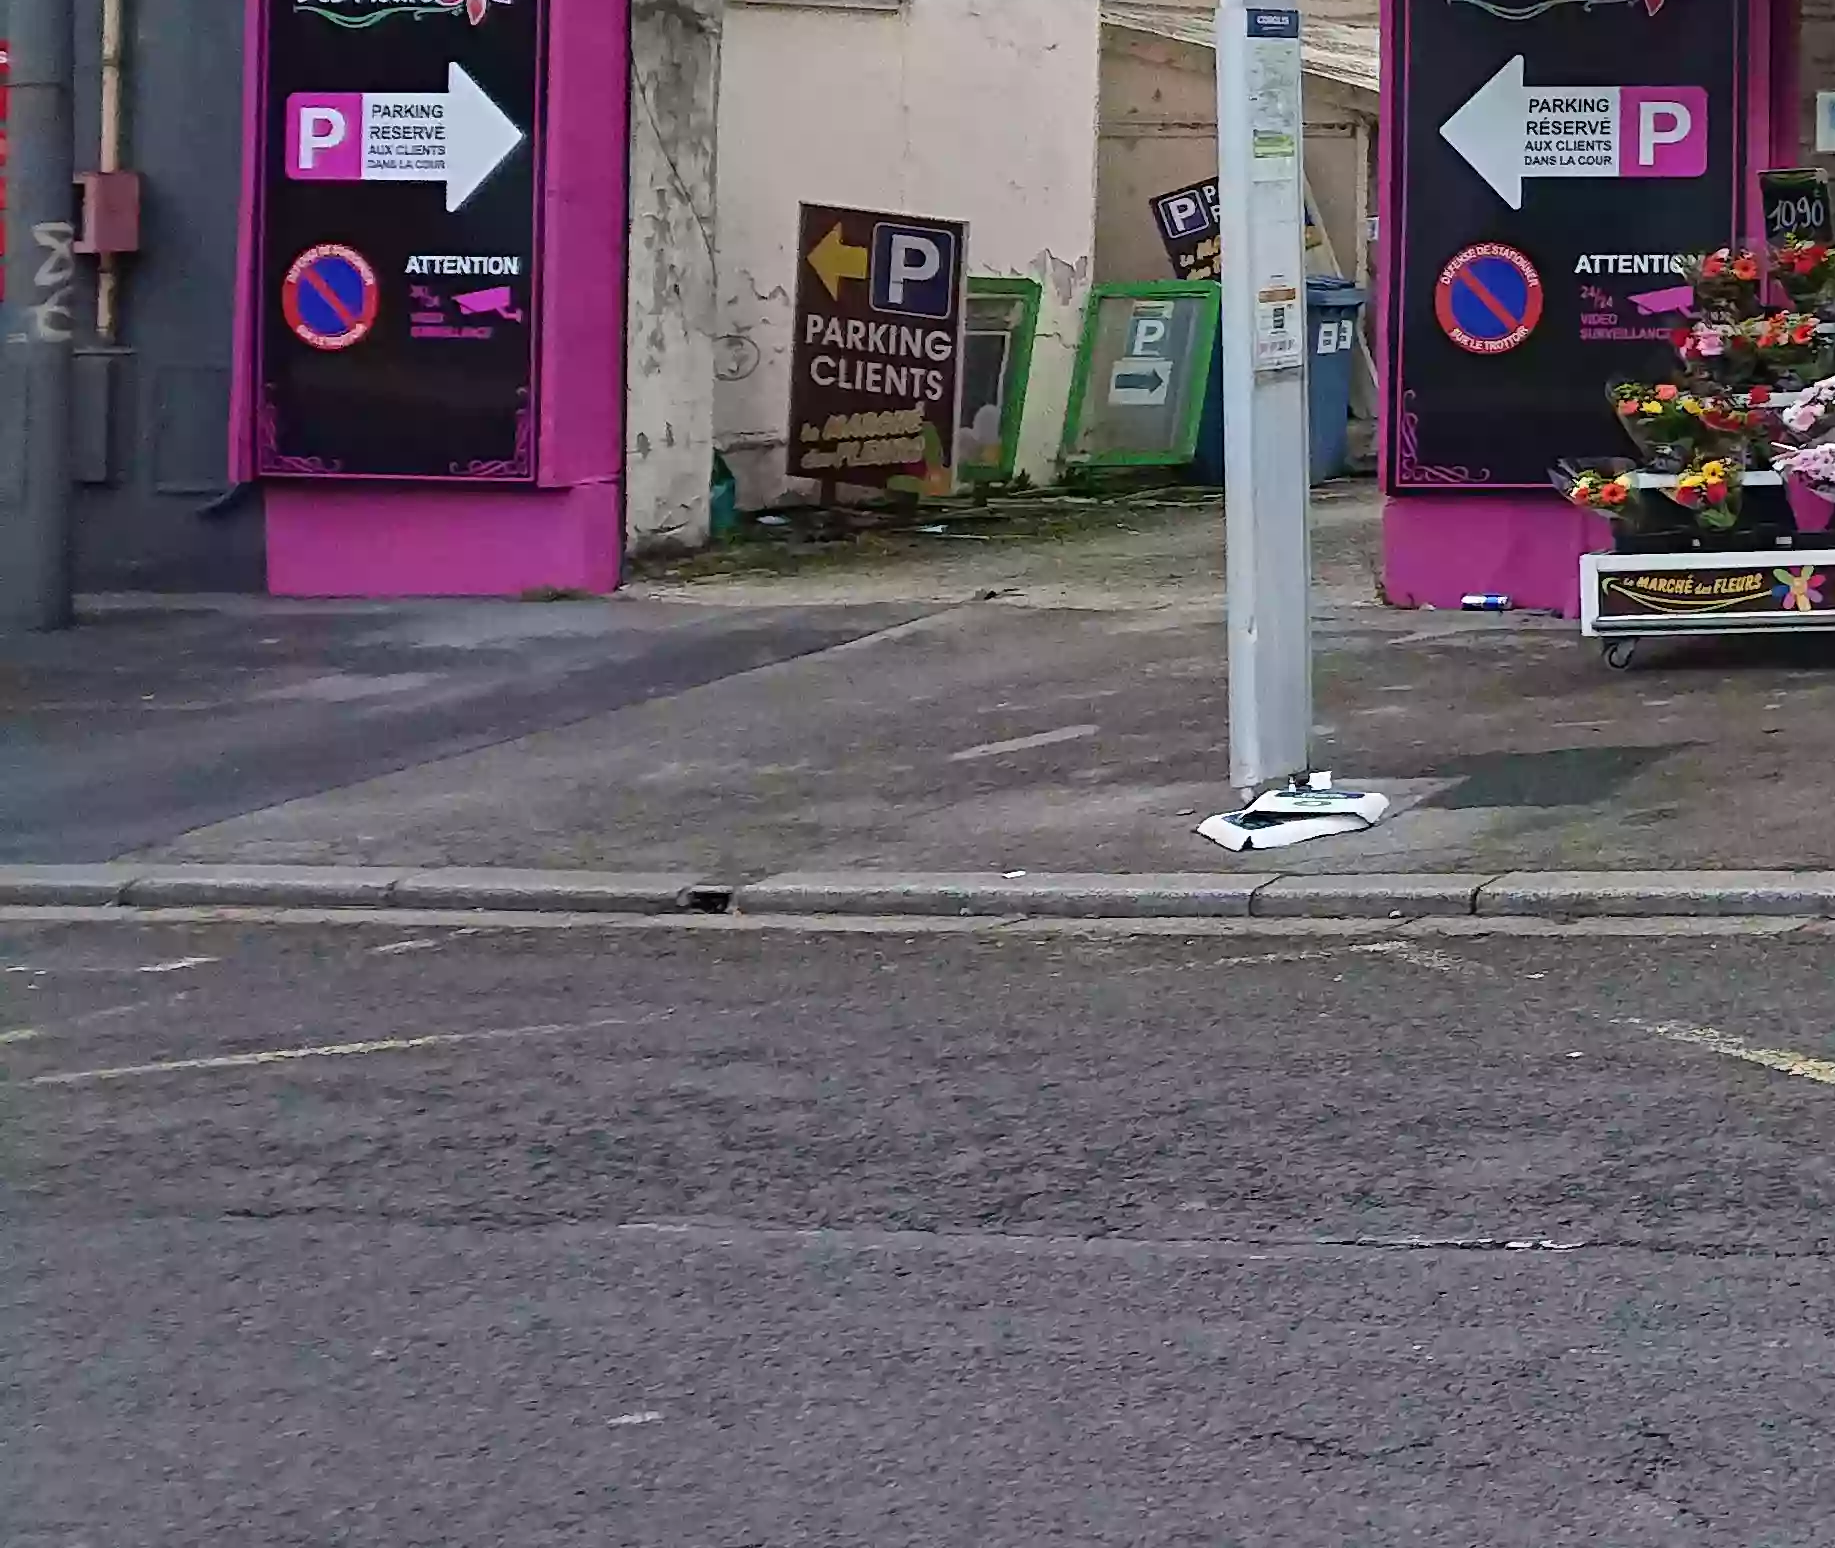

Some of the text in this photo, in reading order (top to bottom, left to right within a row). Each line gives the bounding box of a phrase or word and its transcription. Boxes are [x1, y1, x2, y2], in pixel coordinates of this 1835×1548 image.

[372, 104, 444, 119] PARKING
[1528, 98, 1610, 114] PARKING
[298, 106, 346, 169] P
[1638, 101, 1692, 166] P
[1524, 140, 1612, 152] AUX CLIENTS
[1524, 156, 1613, 166] DANS LA COUR
[1167, 197, 1198, 232] P
[404, 255, 520, 276] ATTENTION
[888, 233, 940, 304] P
[805, 313, 952, 361] PARKING
[1580, 328, 1672, 340] SURVEILLANC
[810, 355, 943, 401] CLIENTS
[1636, 573, 1694, 595] MARCHÉ
[1713, 572, 1763, 595] FLEURS
